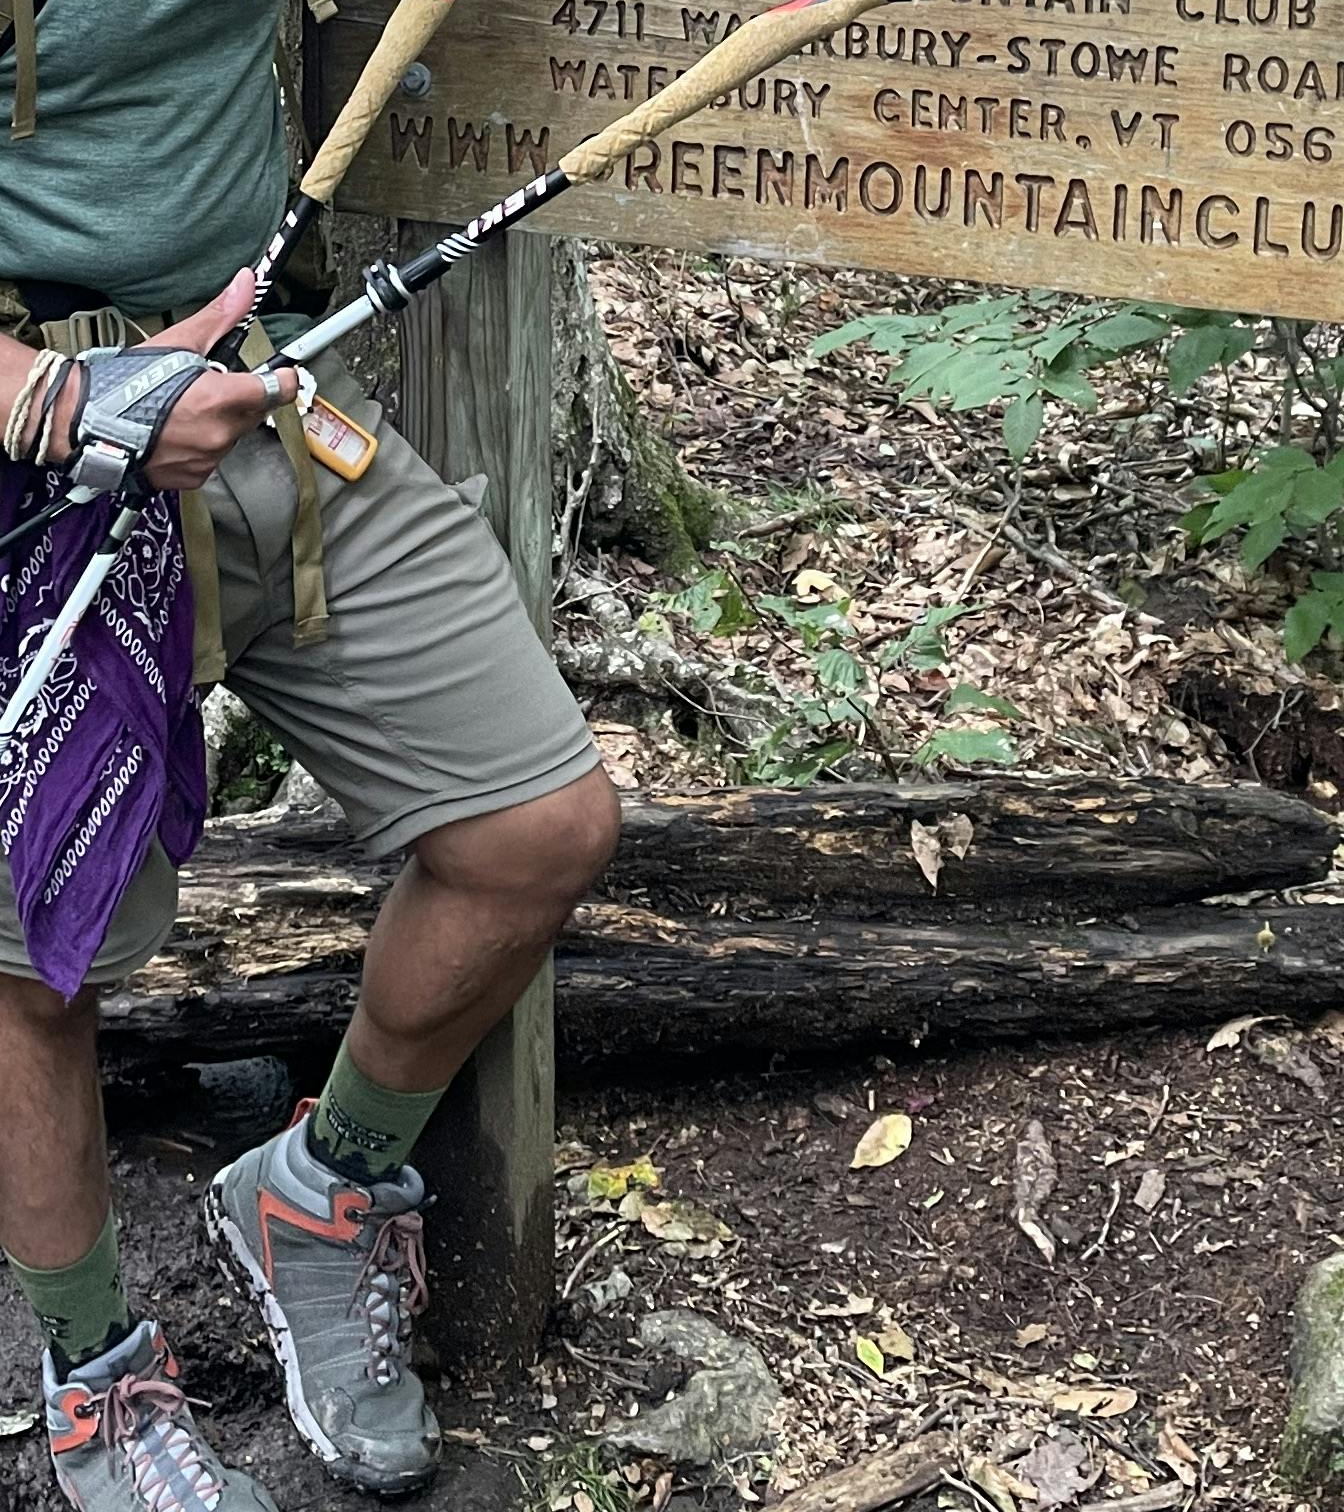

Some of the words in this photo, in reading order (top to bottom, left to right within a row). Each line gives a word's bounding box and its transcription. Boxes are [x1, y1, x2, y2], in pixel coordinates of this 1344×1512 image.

[1110, 108, 1180, 152] VT
[465, 173, 547, 241] LEKI
[123, 354, 180, 403] LEKI
